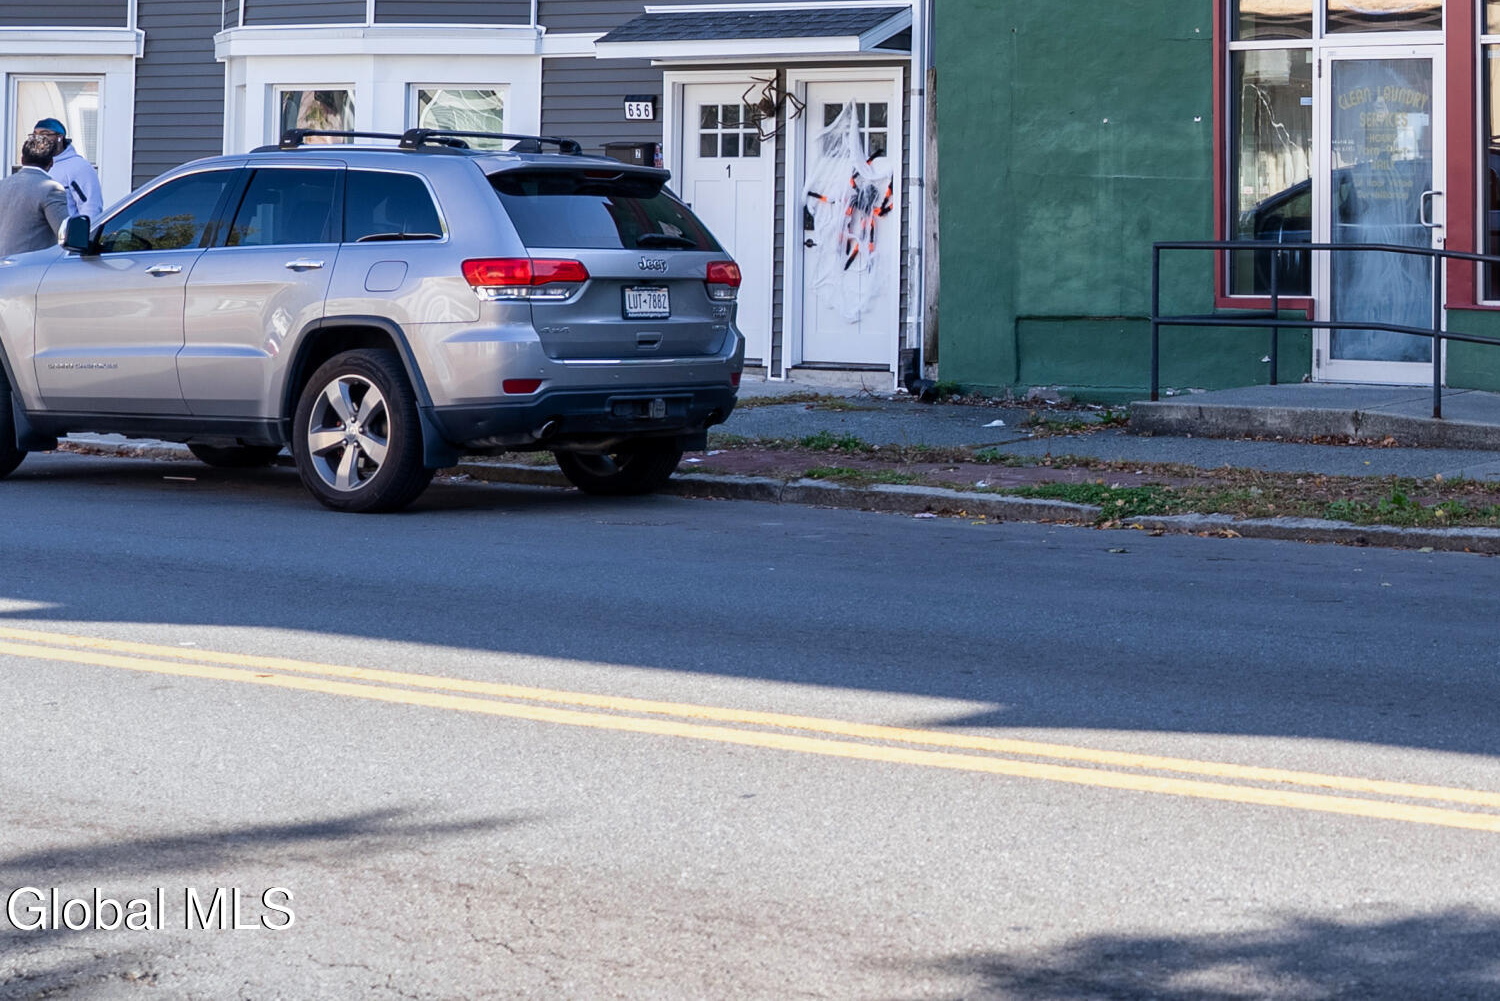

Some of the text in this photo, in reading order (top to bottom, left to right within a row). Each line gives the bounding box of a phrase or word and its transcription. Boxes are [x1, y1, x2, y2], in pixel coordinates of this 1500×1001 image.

[628, 103, 650, 117] 656
[725, 164, 731, 179] 1
[638, 256, 668, 273] Jeep
